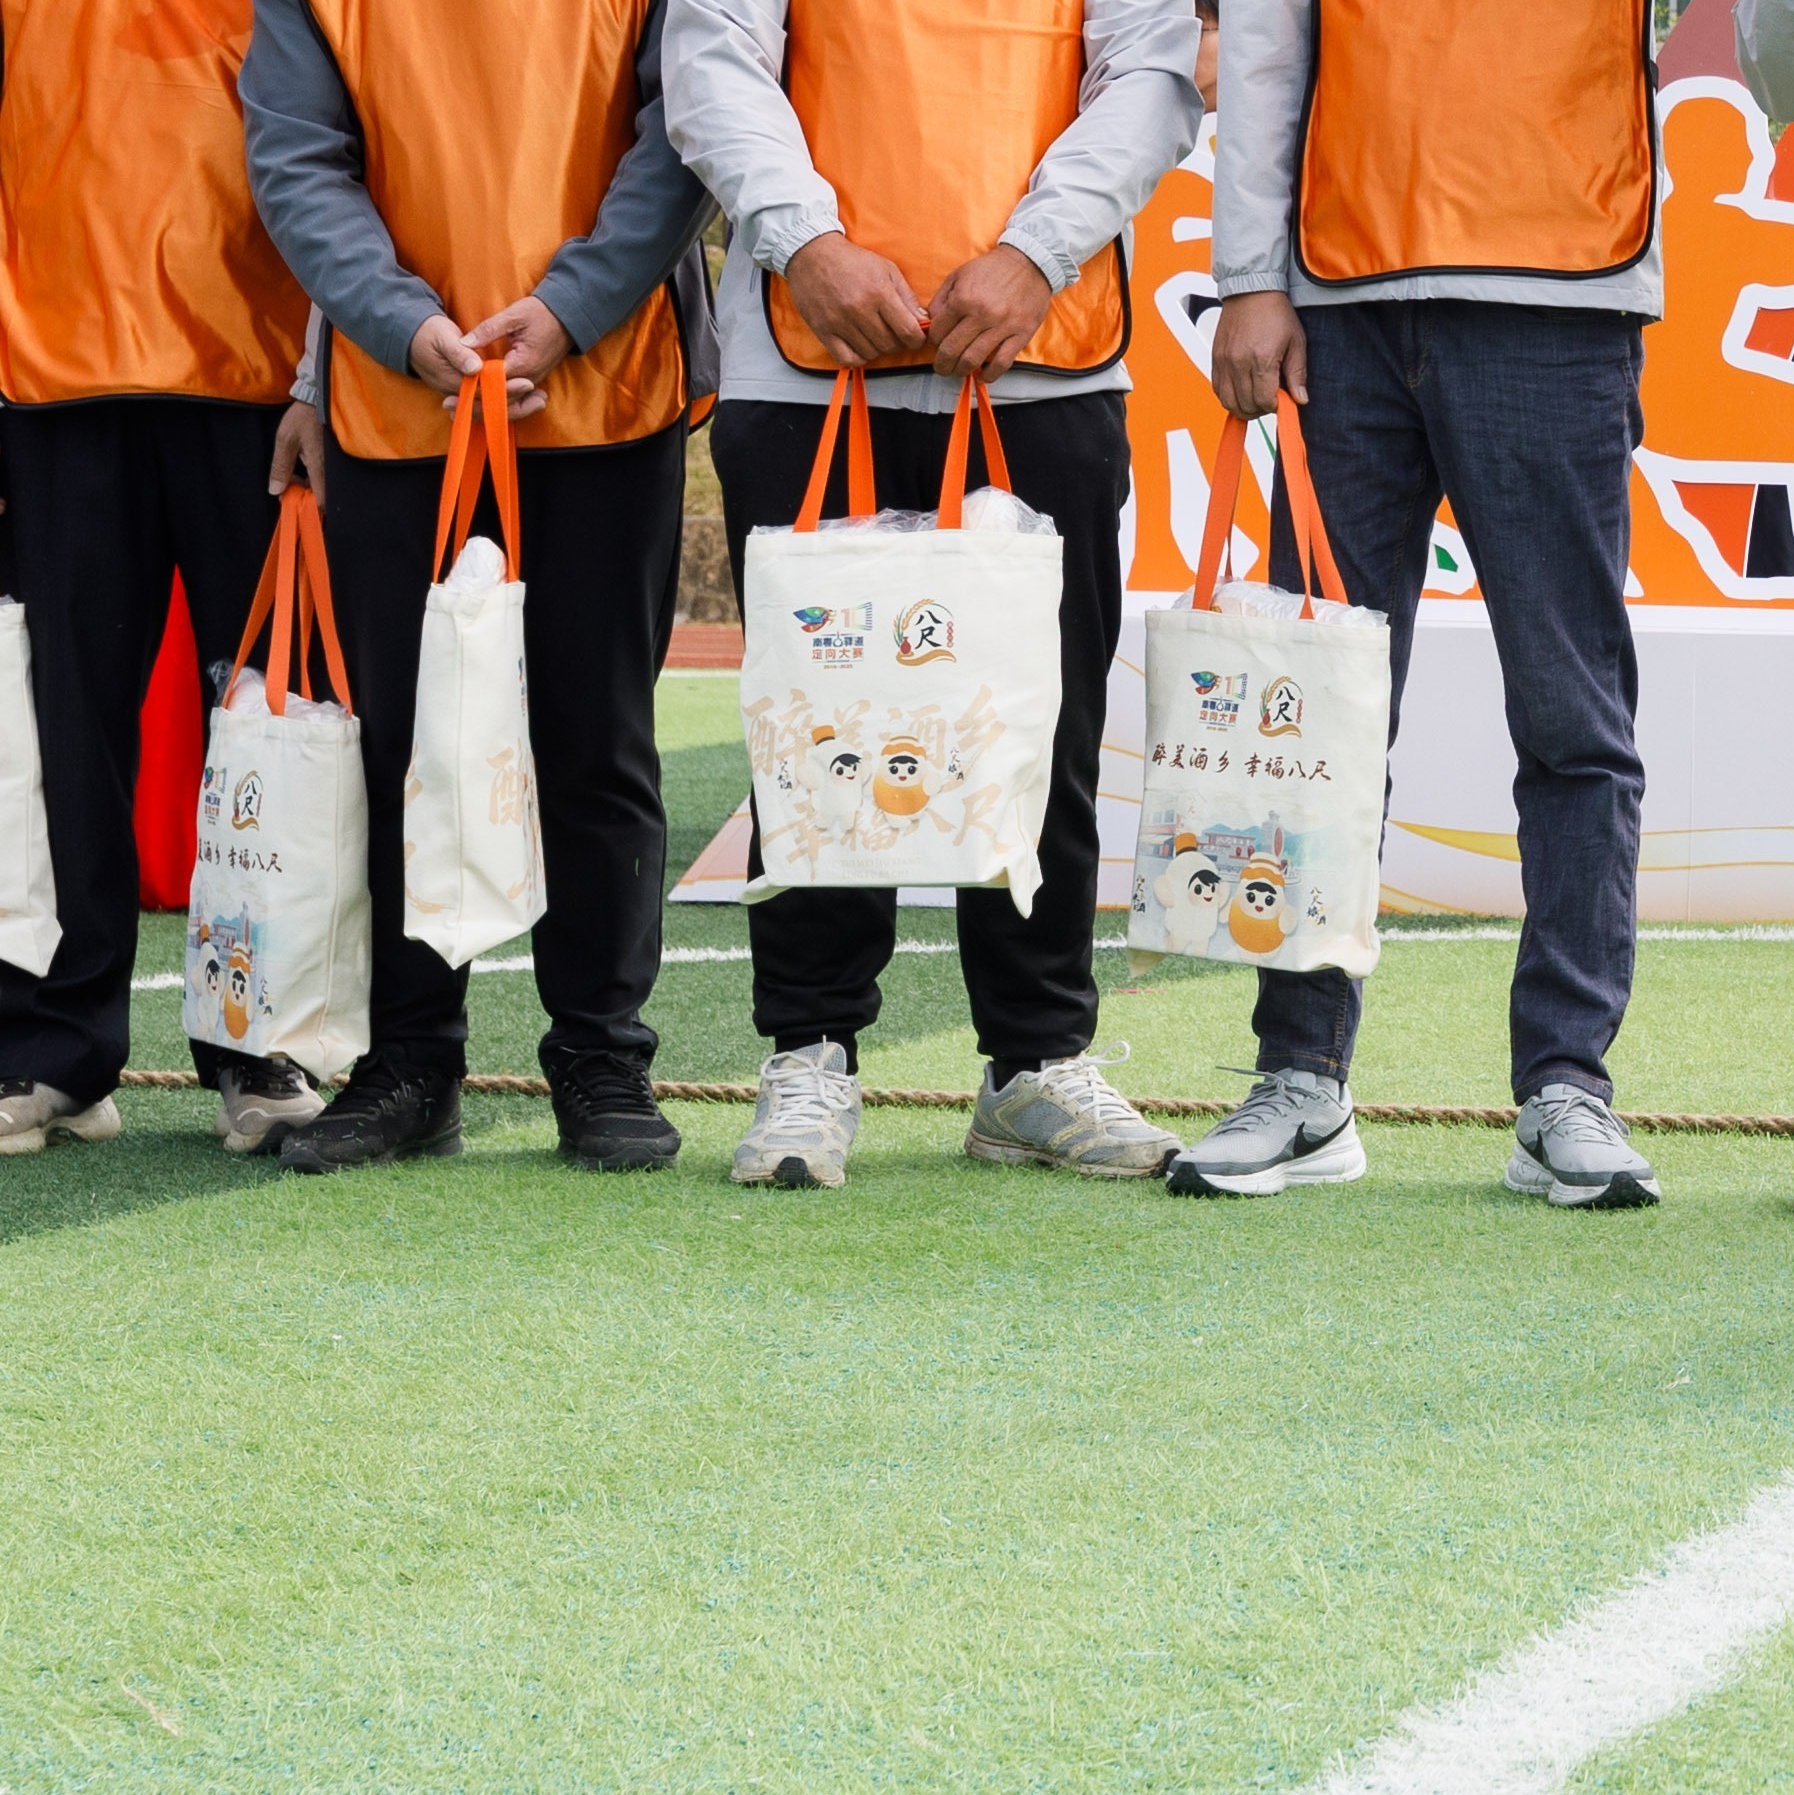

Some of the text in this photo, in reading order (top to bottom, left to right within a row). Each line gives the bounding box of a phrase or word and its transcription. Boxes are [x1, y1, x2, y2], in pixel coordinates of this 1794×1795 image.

[914, 609, 943, 649] 八尺
[1273, 686, 1295, 722] 八尺
[1152, 742, 1332, 781] 醉美酒乡 幸福八尺
[241, 780, 257, 816] 八尺
[228, 846, 282, 873] 幸福八尺
